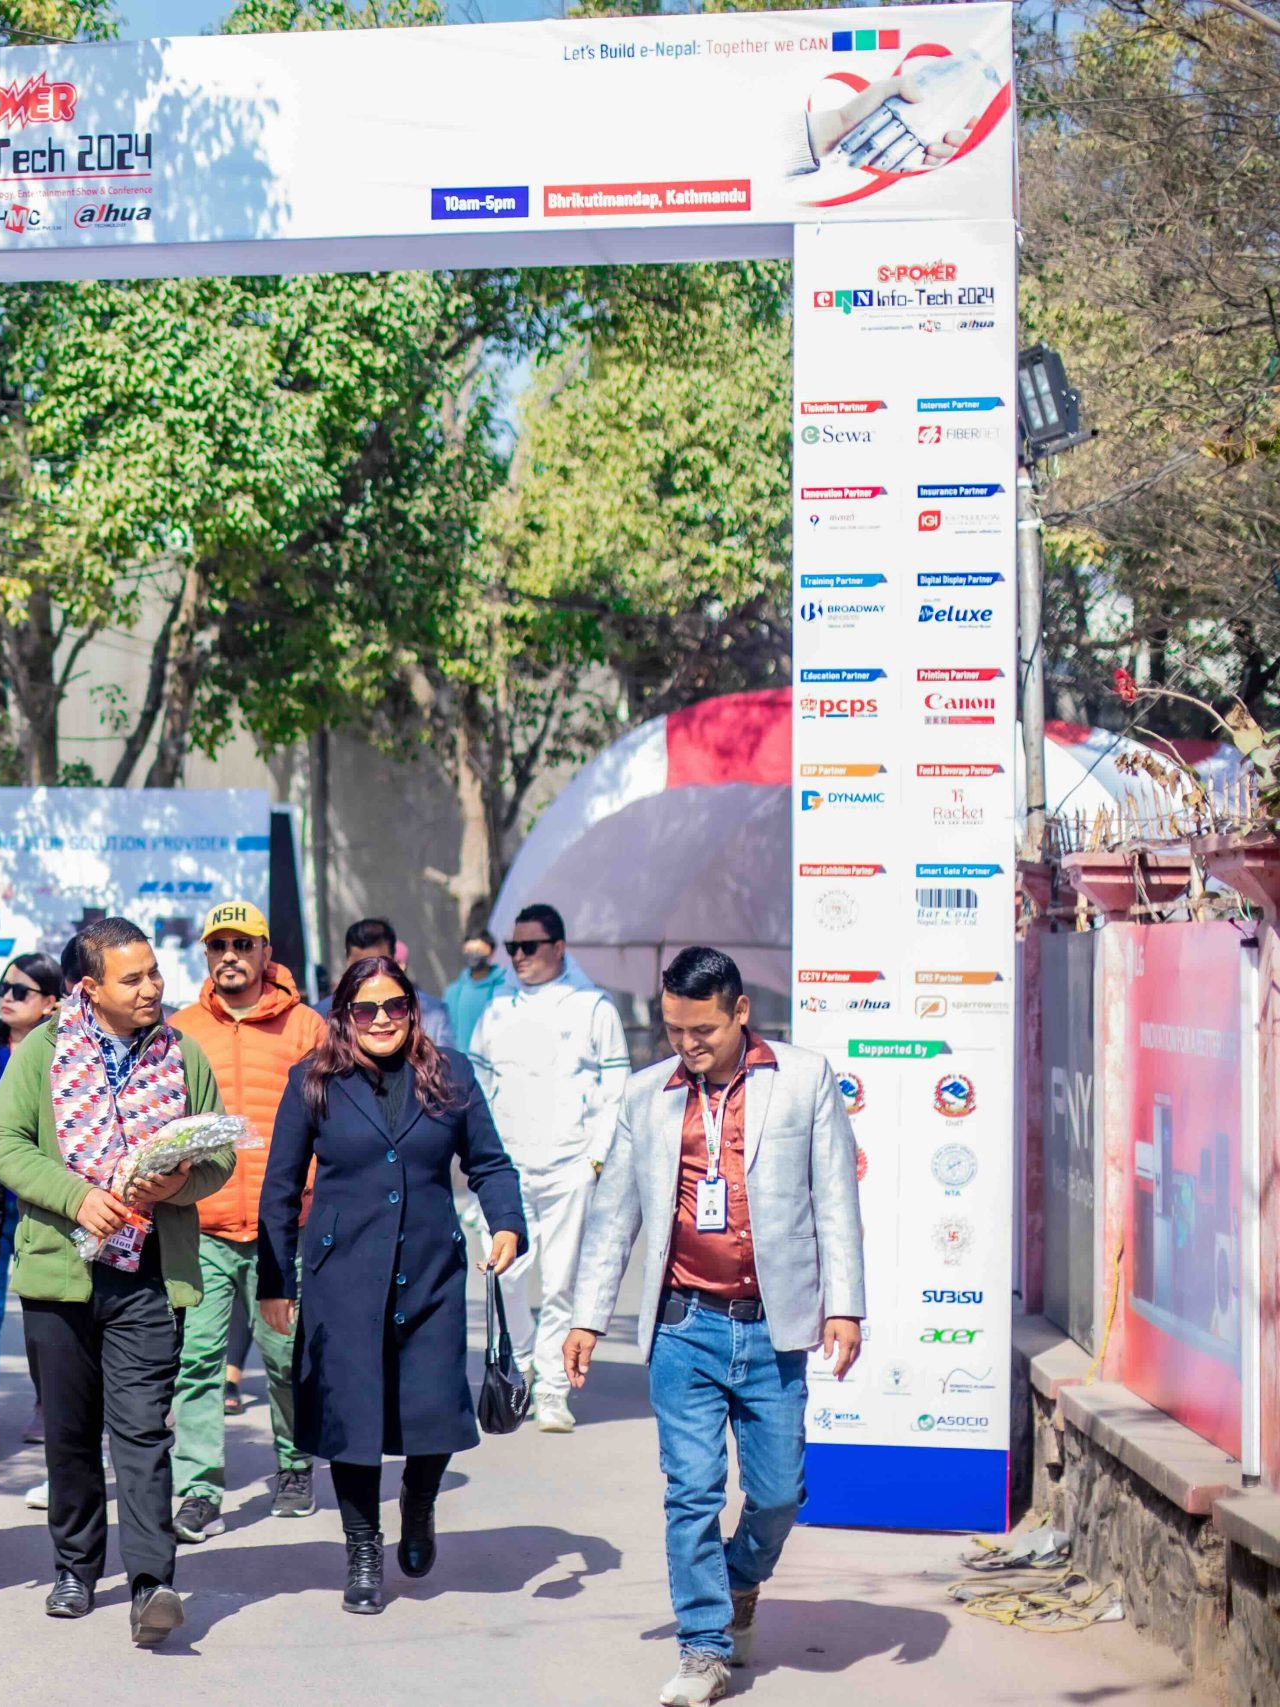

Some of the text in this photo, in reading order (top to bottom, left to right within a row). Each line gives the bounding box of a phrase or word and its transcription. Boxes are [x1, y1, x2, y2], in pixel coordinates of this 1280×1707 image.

[564, 38, 829, 60] Let's Build e-Nepal: Together we CAN
[78, 133, 151, 171] 2024
[76, 187, 97, 196] Show
[108, 185, 152, 195] Conference
[444, 188, 747, 212] 10am-5pm Bhrikutimandap, Kathmandu
[877, 289, 952, 307] Info-Tech
[958, 287, 994, 304] 2024
[803, 403, 868, 414] Ticketing Partner
[920, 401, 979, 409] Internet Partner
[844, 488, 873, 498] Partner
[920, 487, 988, 496] Insurance Partner
[921, 514, 938, 526] IGI
[804, 577, 864, 587] Training Partner
[920, 575, 993, 585] Digital Display Partner
[827, 605, 885, 613] BROADWAY
[918, 605, 992, 622] Deluxe
[803, 671, 870, 680] Education Partner
[920, 671, 980, 681] Printing Partner
[924, 693, 995, 709] Canon
[819, 698, 878, 717] pcps
[819, 766, 847, 775] Partner
[970, 766, 994, 775] Partner
[828, 792, 885, 803] DYNAMIC
[933, 805, 983, 819] Racket
[71, 835, 228, 850] SOLUTION PROVIDER
[852, 866, 874, 875] Partner
[919, 867, 990, 875] Smart Gate Partner
[212, 907, 246, 925] NSH
[917, 908, 978, 919] Bar Code
[800, 972, 850, 981] CCTV Partner
[934, 974, 963, 982] Partner
[858, 1043, 927, 1056] Supported By
[920, 1328, 983, 1344] acer
[937, 1416, 988, 1426] ASOCIO
